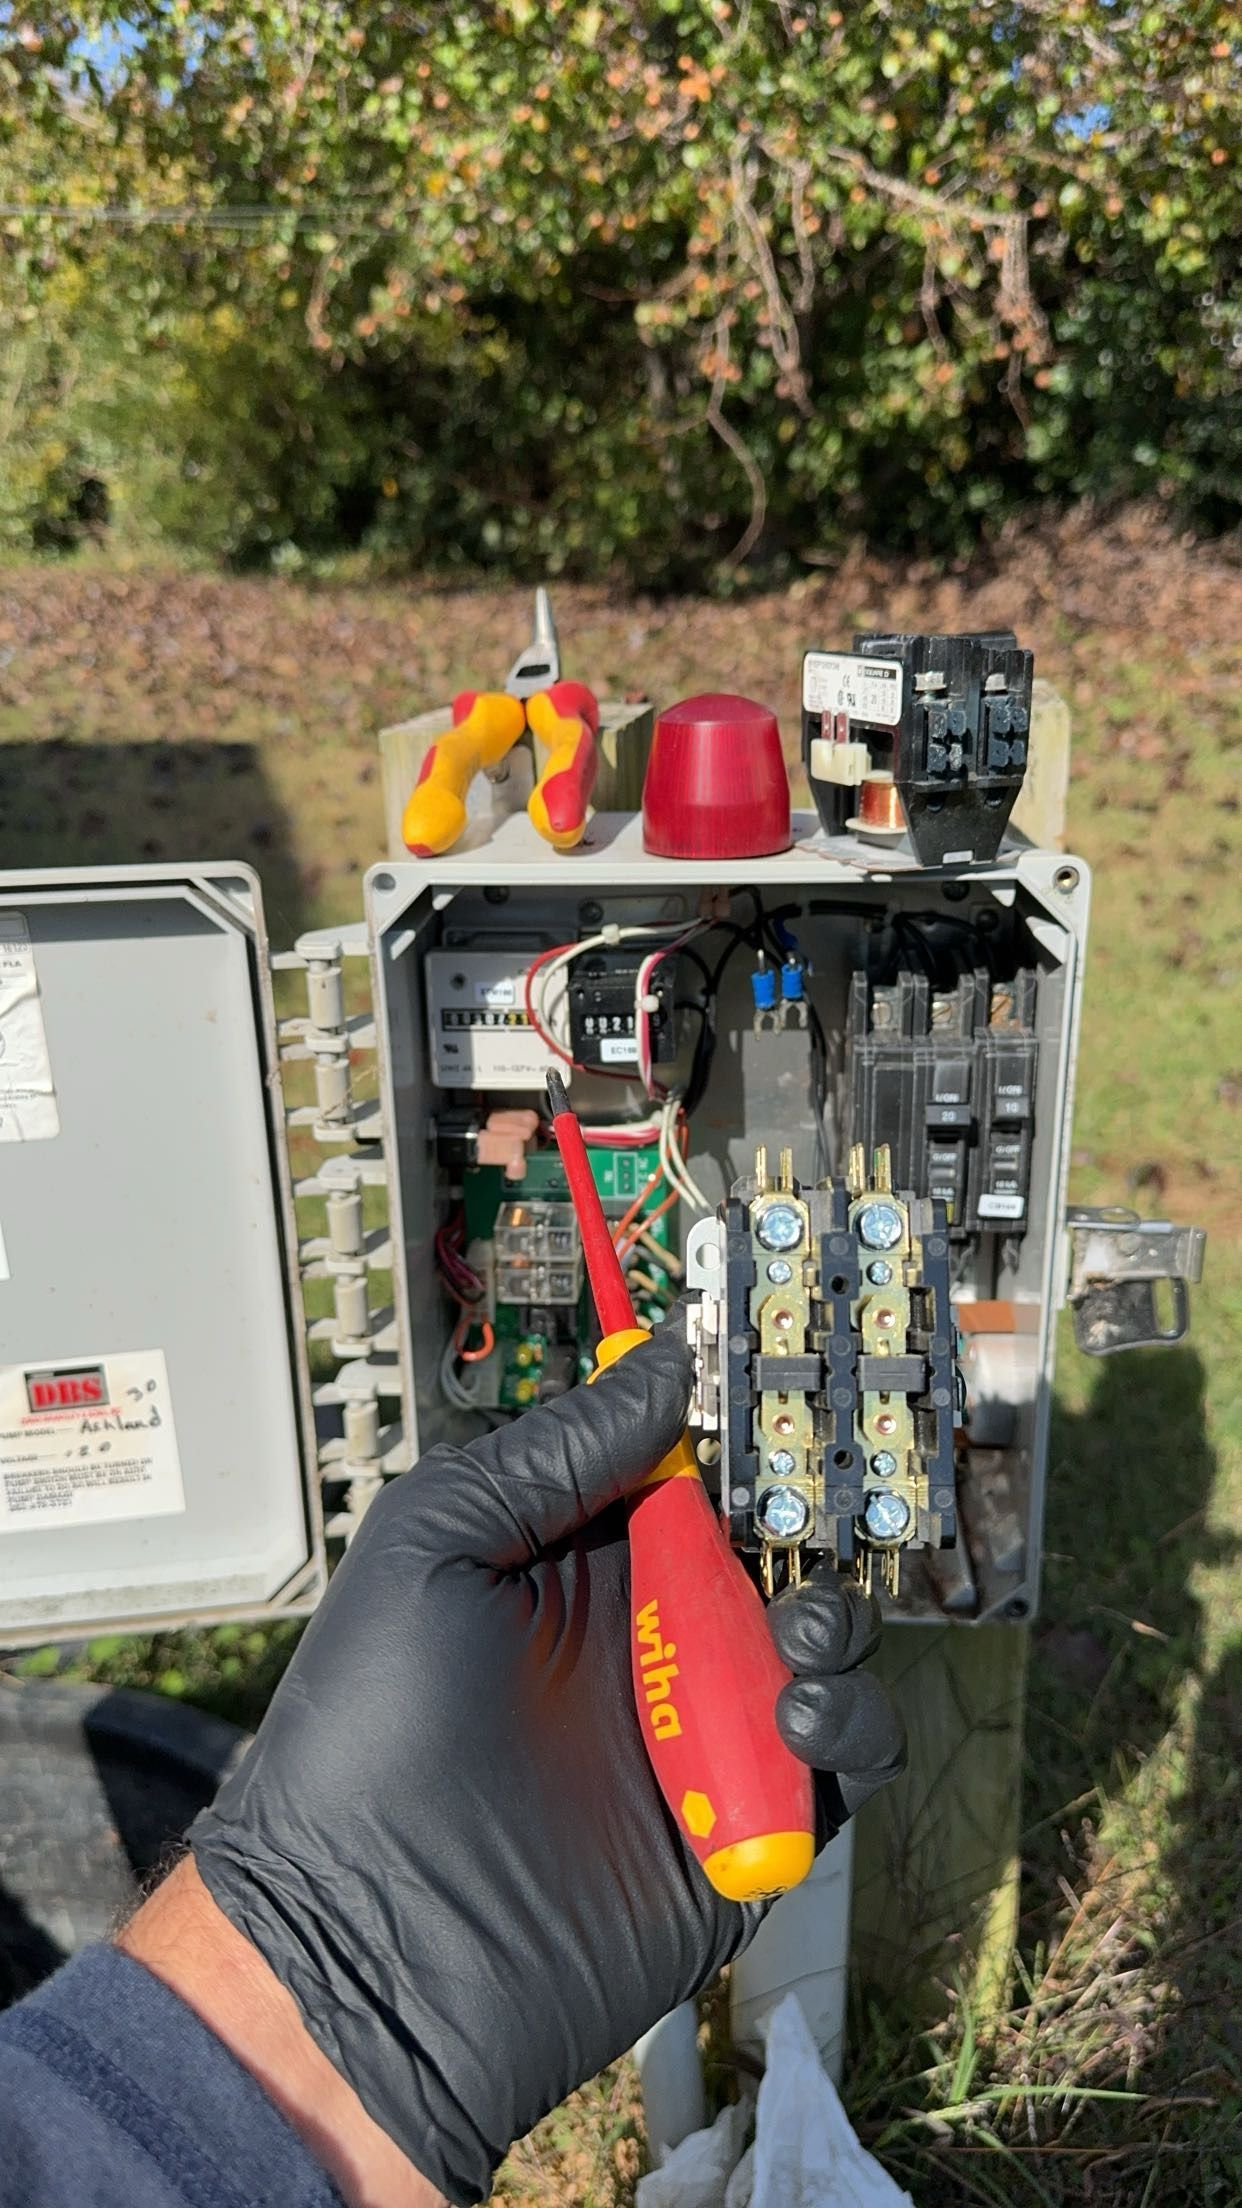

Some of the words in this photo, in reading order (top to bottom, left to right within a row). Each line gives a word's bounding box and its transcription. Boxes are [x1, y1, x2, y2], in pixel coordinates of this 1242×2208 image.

[941, 1110, 957, 1122] 20
[32, 1377, 104, 1408] DBS
[81, 1404, 162, 1435] Ashland
[636, 1600, 682, 1741] wiha
